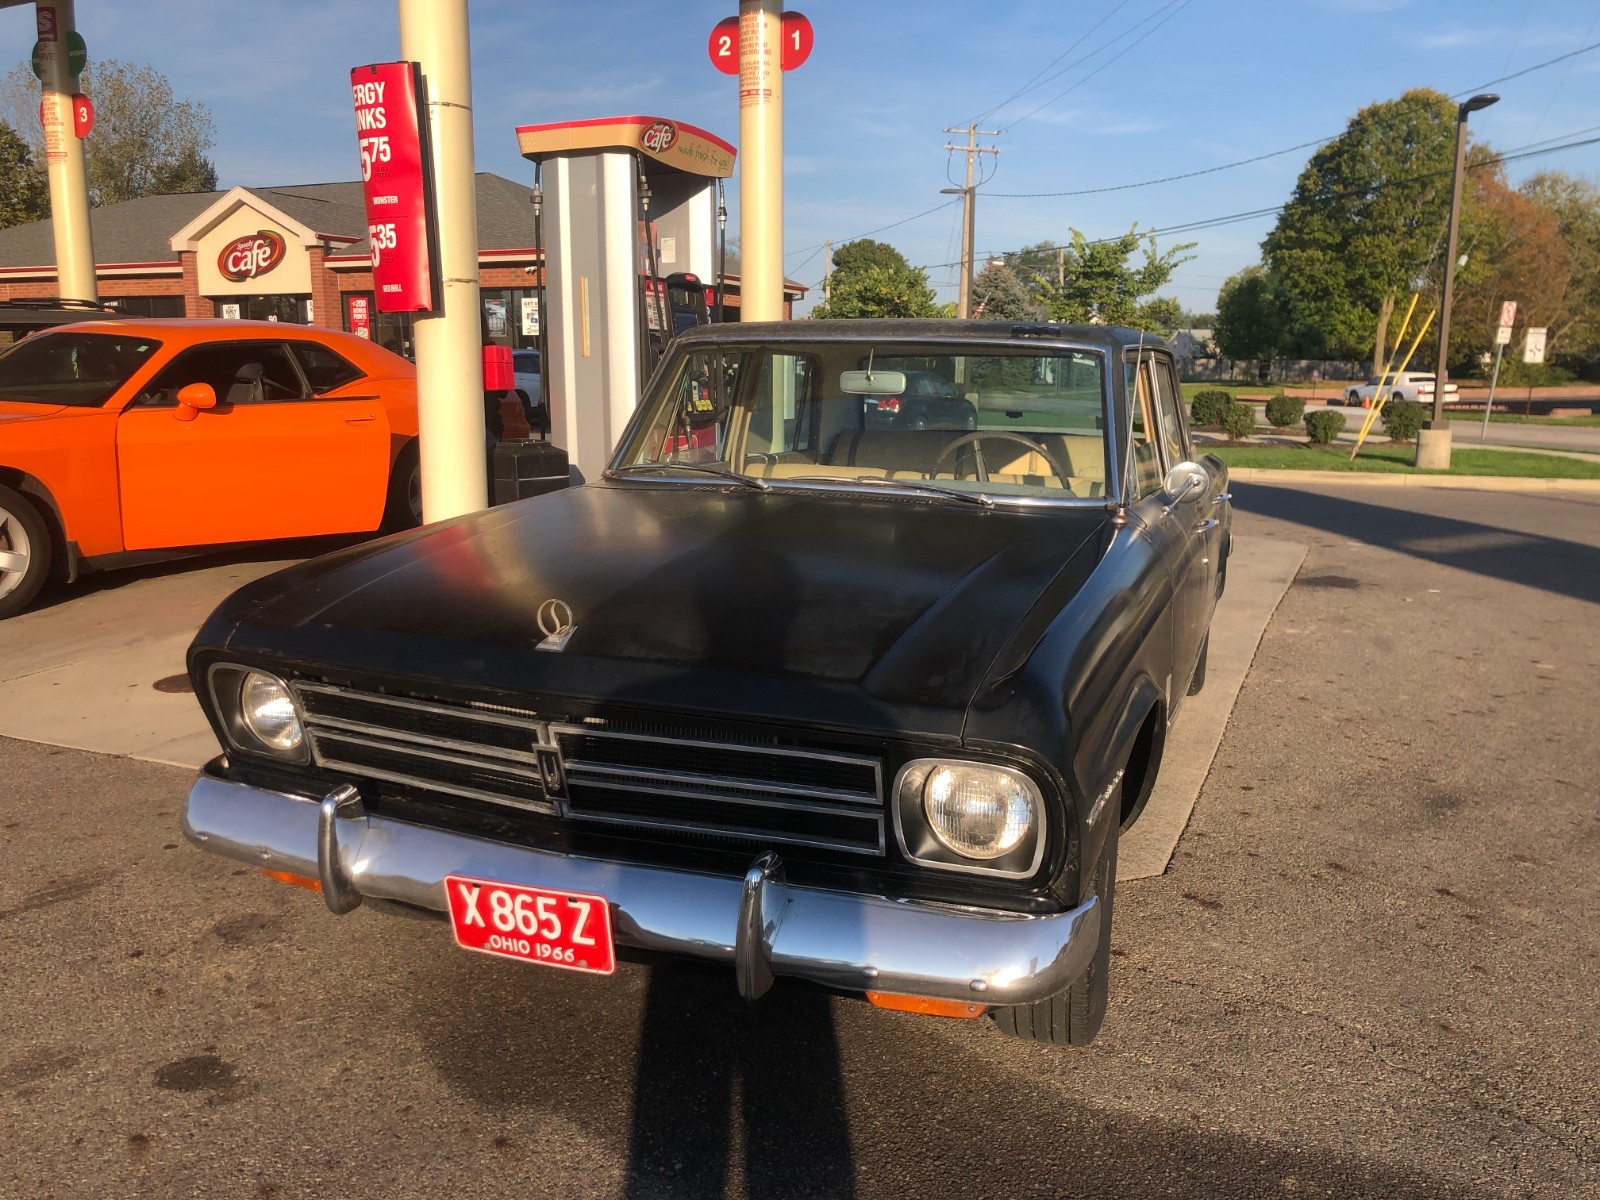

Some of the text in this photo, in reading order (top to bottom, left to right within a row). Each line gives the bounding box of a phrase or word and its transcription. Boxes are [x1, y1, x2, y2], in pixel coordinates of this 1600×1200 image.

[718, 35, 732, 56] 2
[791, 29, 800, 51] 1
[80, 106, 88, 123] 3
[459, 883, 596, 946] X 865 Z
[489, 934, 575, 963] OHIO 1966
